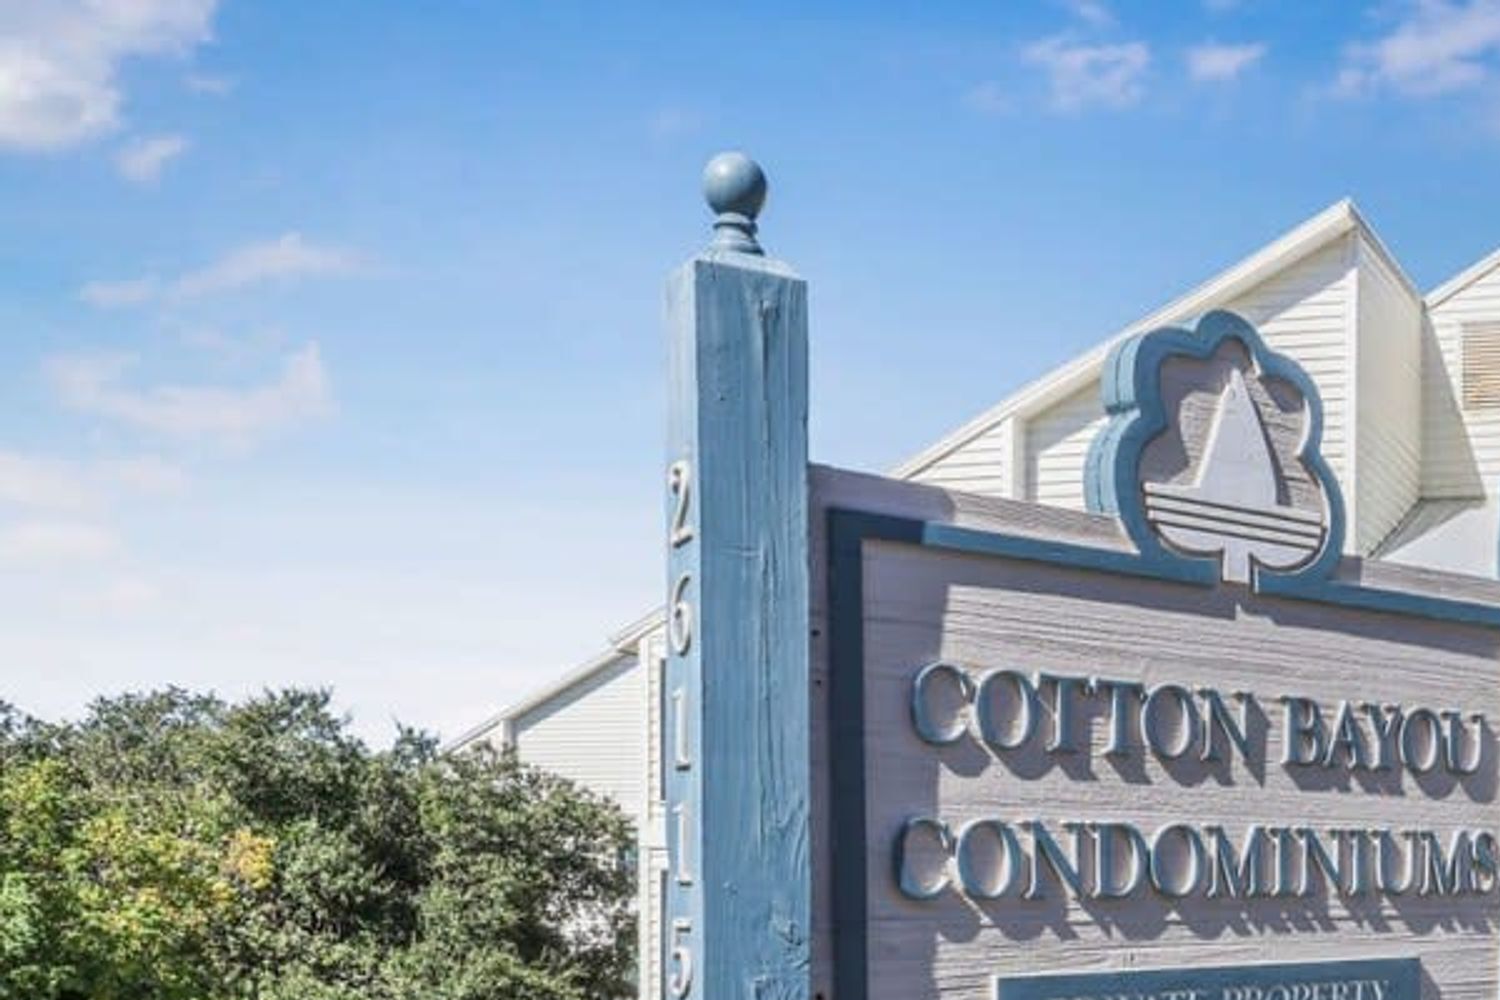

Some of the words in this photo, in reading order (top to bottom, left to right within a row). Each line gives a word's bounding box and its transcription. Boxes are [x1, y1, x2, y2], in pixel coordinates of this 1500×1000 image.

[668, 460, 693, 1000] 26115
[911, 662, 1255, 766] COTTON
[1280, 694, 1486, 774] BAYOU
[896, 815, 1497, 900] CONDOMINIUMS
